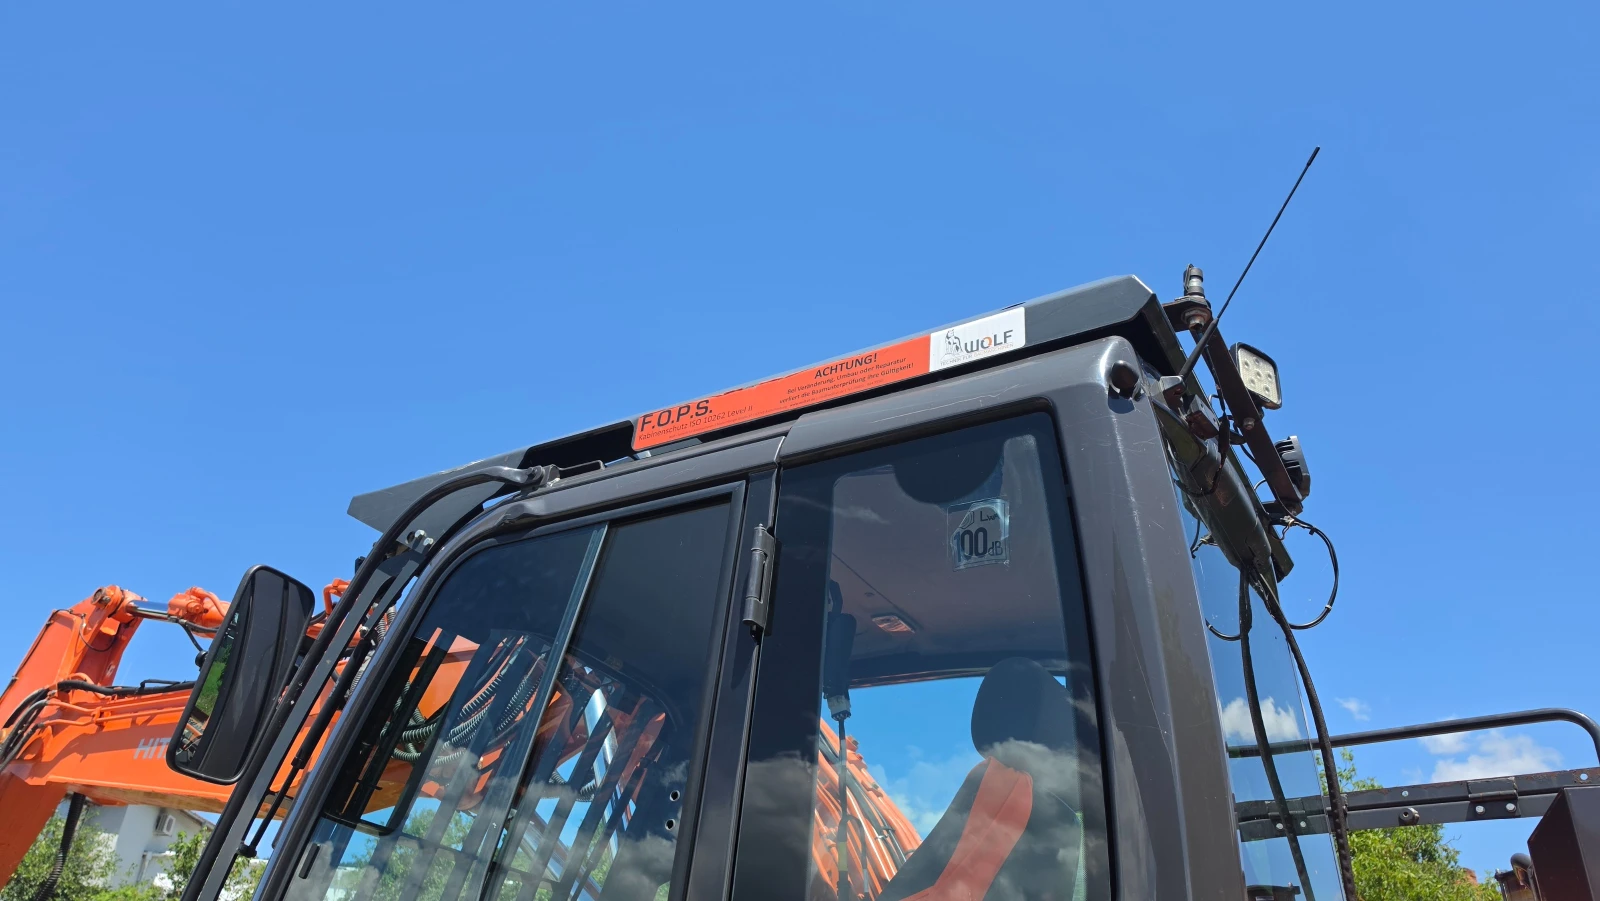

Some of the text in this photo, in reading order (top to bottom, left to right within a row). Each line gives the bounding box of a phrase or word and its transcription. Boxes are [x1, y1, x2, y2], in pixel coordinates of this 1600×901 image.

[964, 329, 1013, 354] WOLF
[787, 386, 796, 395] Bei
[836, 370, 858, 381] Umbau
[859, 365, 874, 375] oder
[875, 357, 907, 371] Reparatur
[814, 353, 877, 379] ACHTUNG!
[779, 394, 800, 404] verliert
[801, 391, 810, 399] die
[867, 371, 879, 380] ihre
[638, 422, 688, 441] Kabinenschutz
[689, 418, 702, 428] ISO
[703, 412, 726, 424] 10262
[727, 406, 747, 418] Level
[640, 400, 713, 432] F.O.P.S.
[954, 527, 1003, 562] 100 dB
[134, 737, 171, 760] HIT
